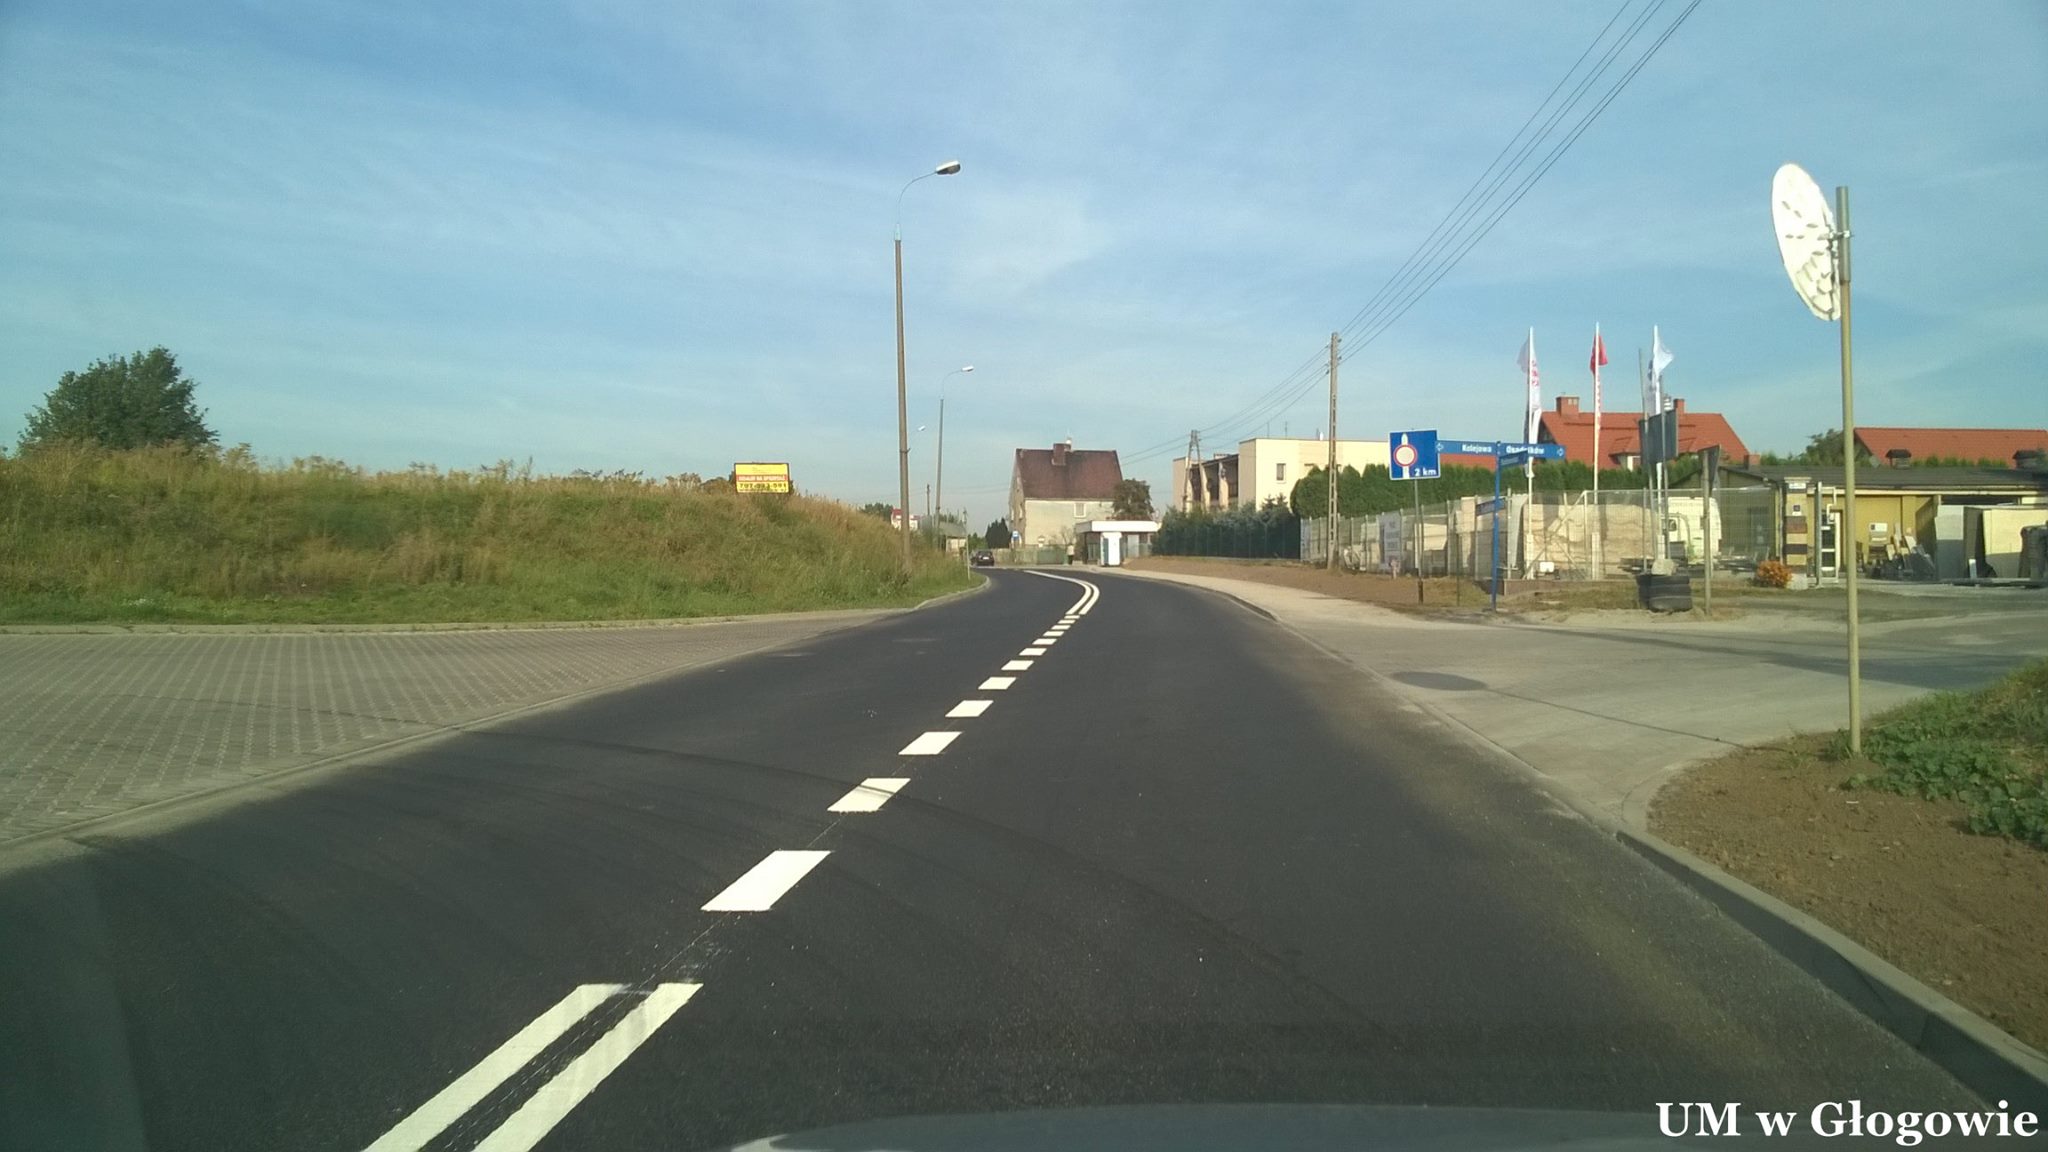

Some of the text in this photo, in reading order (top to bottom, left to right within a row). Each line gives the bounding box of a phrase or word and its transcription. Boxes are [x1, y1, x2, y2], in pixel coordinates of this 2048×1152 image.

[1462, 443, 1492, 454] Kolejowa
[1414, 467, 1437, 477] 2 km
